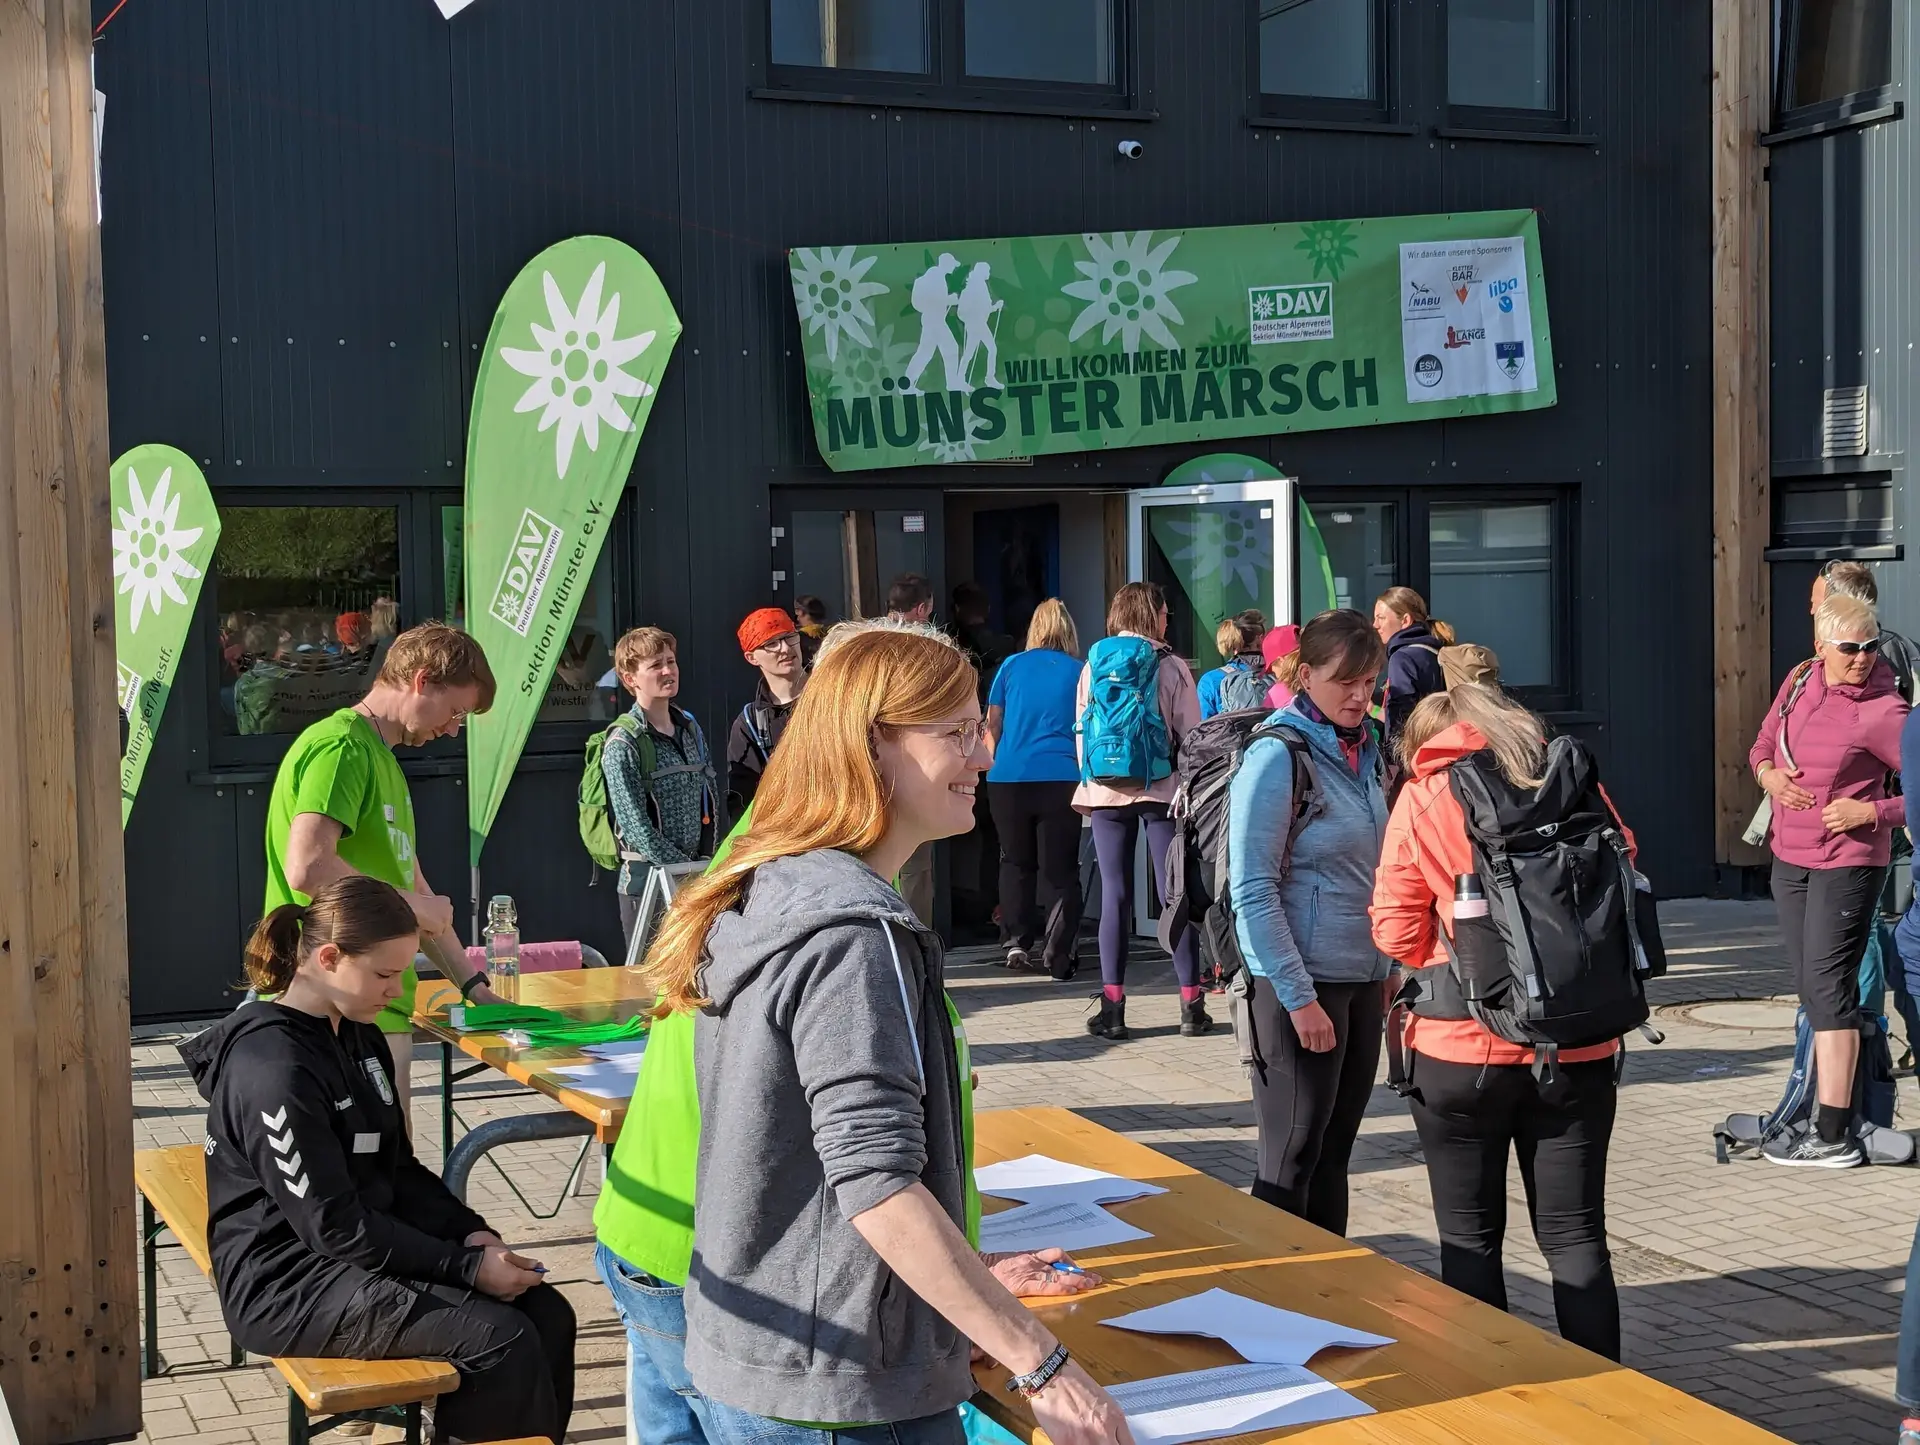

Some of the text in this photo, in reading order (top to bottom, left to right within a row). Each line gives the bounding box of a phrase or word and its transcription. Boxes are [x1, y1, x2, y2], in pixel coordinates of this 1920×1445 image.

[1407, 245, 1512, 259] Wir danken unseren Sponsoren
[1452, 271, 1473, 281] BAR
[1488, 277, 1518, 298] liba
[1276, 289, 1328, 316] DAV
[1413, 297, 1440, 307] NABU
[1252, 317, 1331, 332] Deutscher Alpenverein
[1252, 329, 1332, 342] Sektion Münster/Westfalen
[1456, 330, 1486, 341] LANGE
[1004, 344, 1250, 384] WILLKOMMEN ZUM
[1419, 361, 1437, 371] ESV
[827, 357, 1380, 452] MÜNSTER MARSCH
[506, 518, 545, 594] DAV
[517, 529, 561, 633] Deutscher Alpenverein
[521, 624, 557, 698] Sektion
[548, 540, 588, 622] Münster
[126, 646, 173, 767] Münster/Westf.
[1031, 1353, 1063, 1388] IMPERICON
